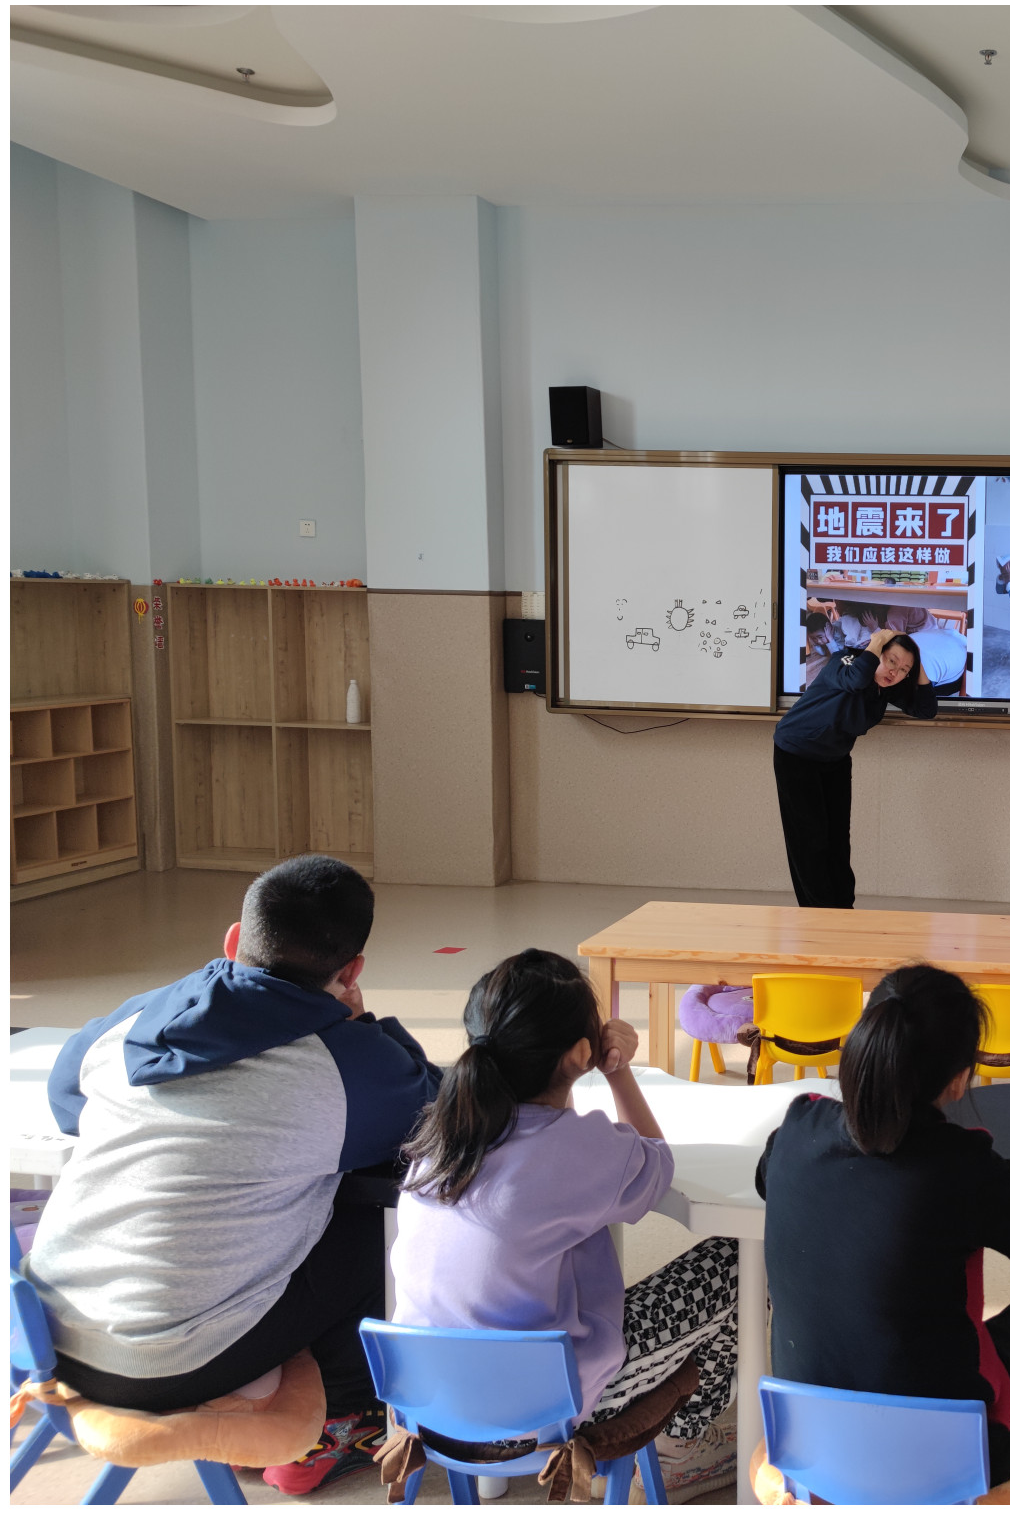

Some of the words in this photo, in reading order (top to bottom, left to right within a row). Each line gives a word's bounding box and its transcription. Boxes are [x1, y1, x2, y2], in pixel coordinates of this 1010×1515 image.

[817, 505, 960, 537] 地震来了
[826, 545, 951, 564] 我们应该这样做
